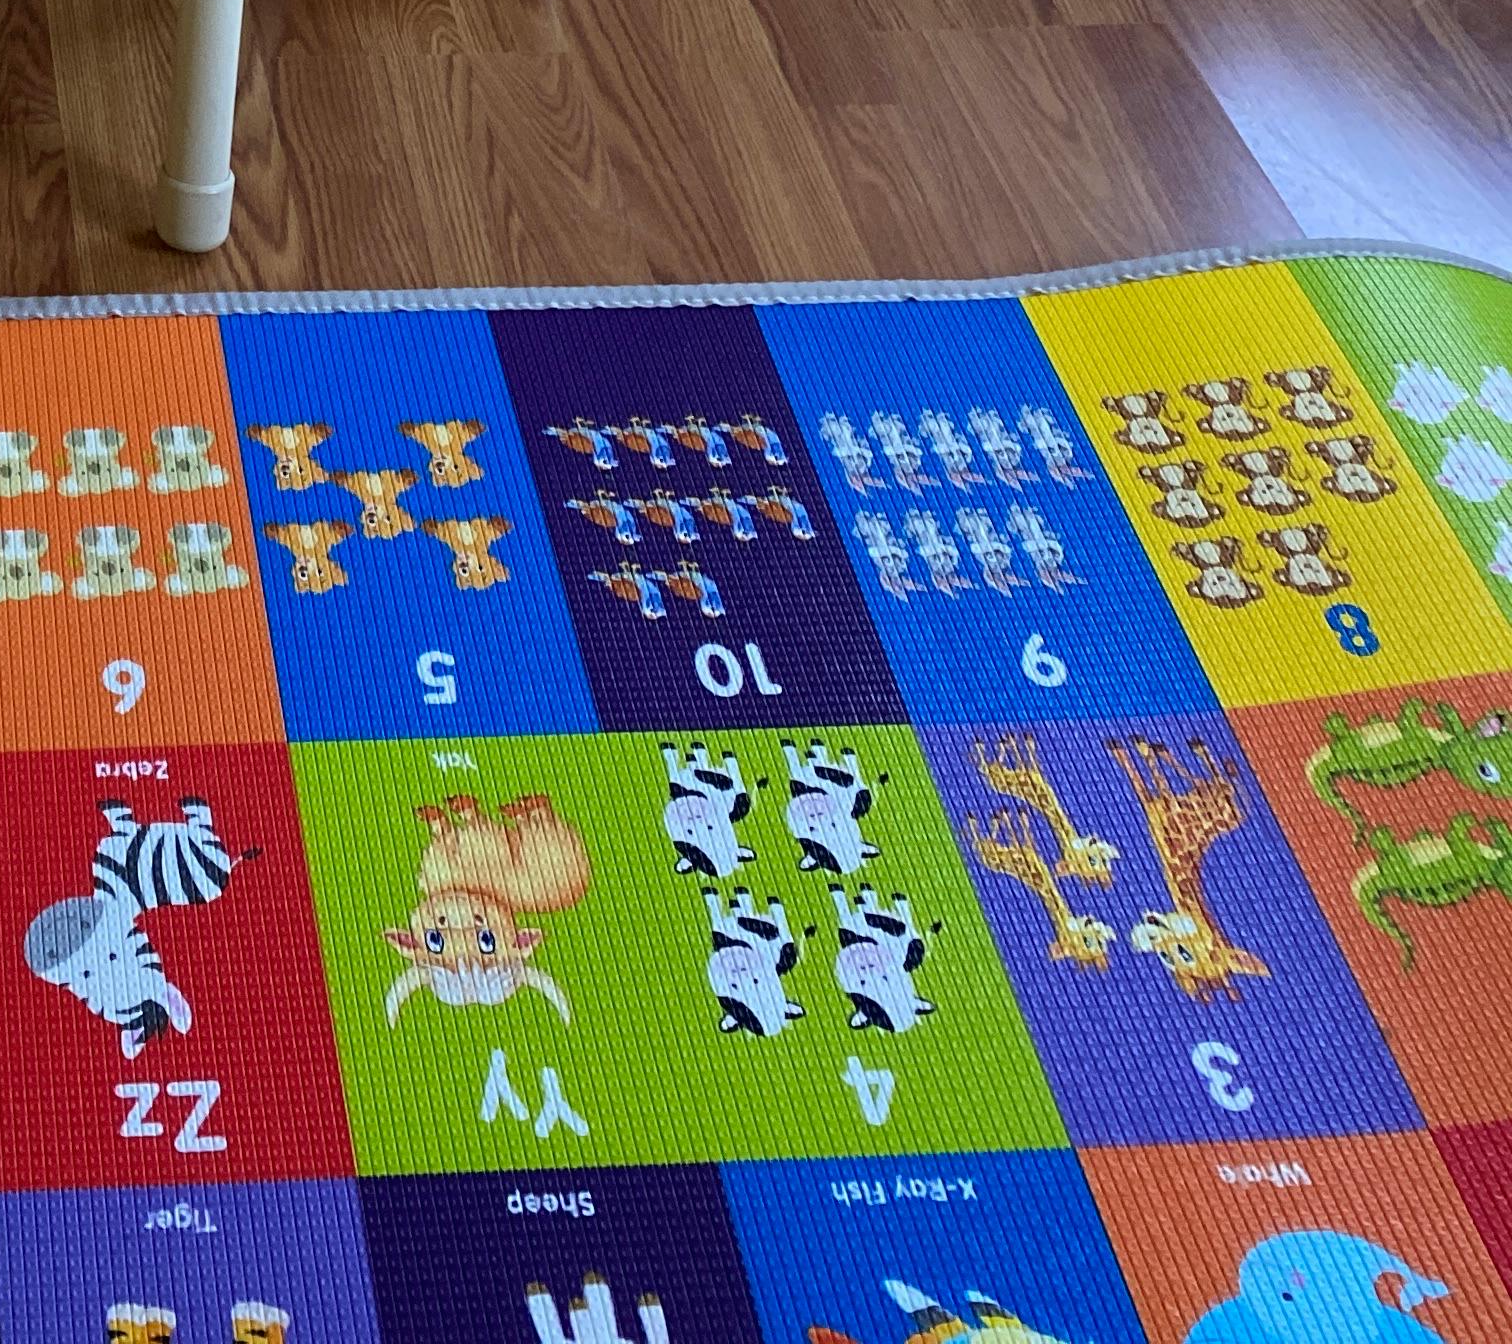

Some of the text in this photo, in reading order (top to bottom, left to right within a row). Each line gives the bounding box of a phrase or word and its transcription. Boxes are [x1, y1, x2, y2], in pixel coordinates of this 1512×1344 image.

[1324, 602, 1381, 657] 8
[416, 650, 458, 705] 5
[694, 642, 784, 698] 10
[95, 759, 170, 781] Zebra
[480, 1048, 589, 1139] Yy
[844, 1055, 895, 1126] 4
[1191, 1041, 1255, 1112] 3
[113, 1078, 228, 1154] Zz
[143, 1203, 219, 1234] Tiger
[506, 1188, 596, 1216] Sheep
[831, 1176, 978, 1207] X-Ray Fish
